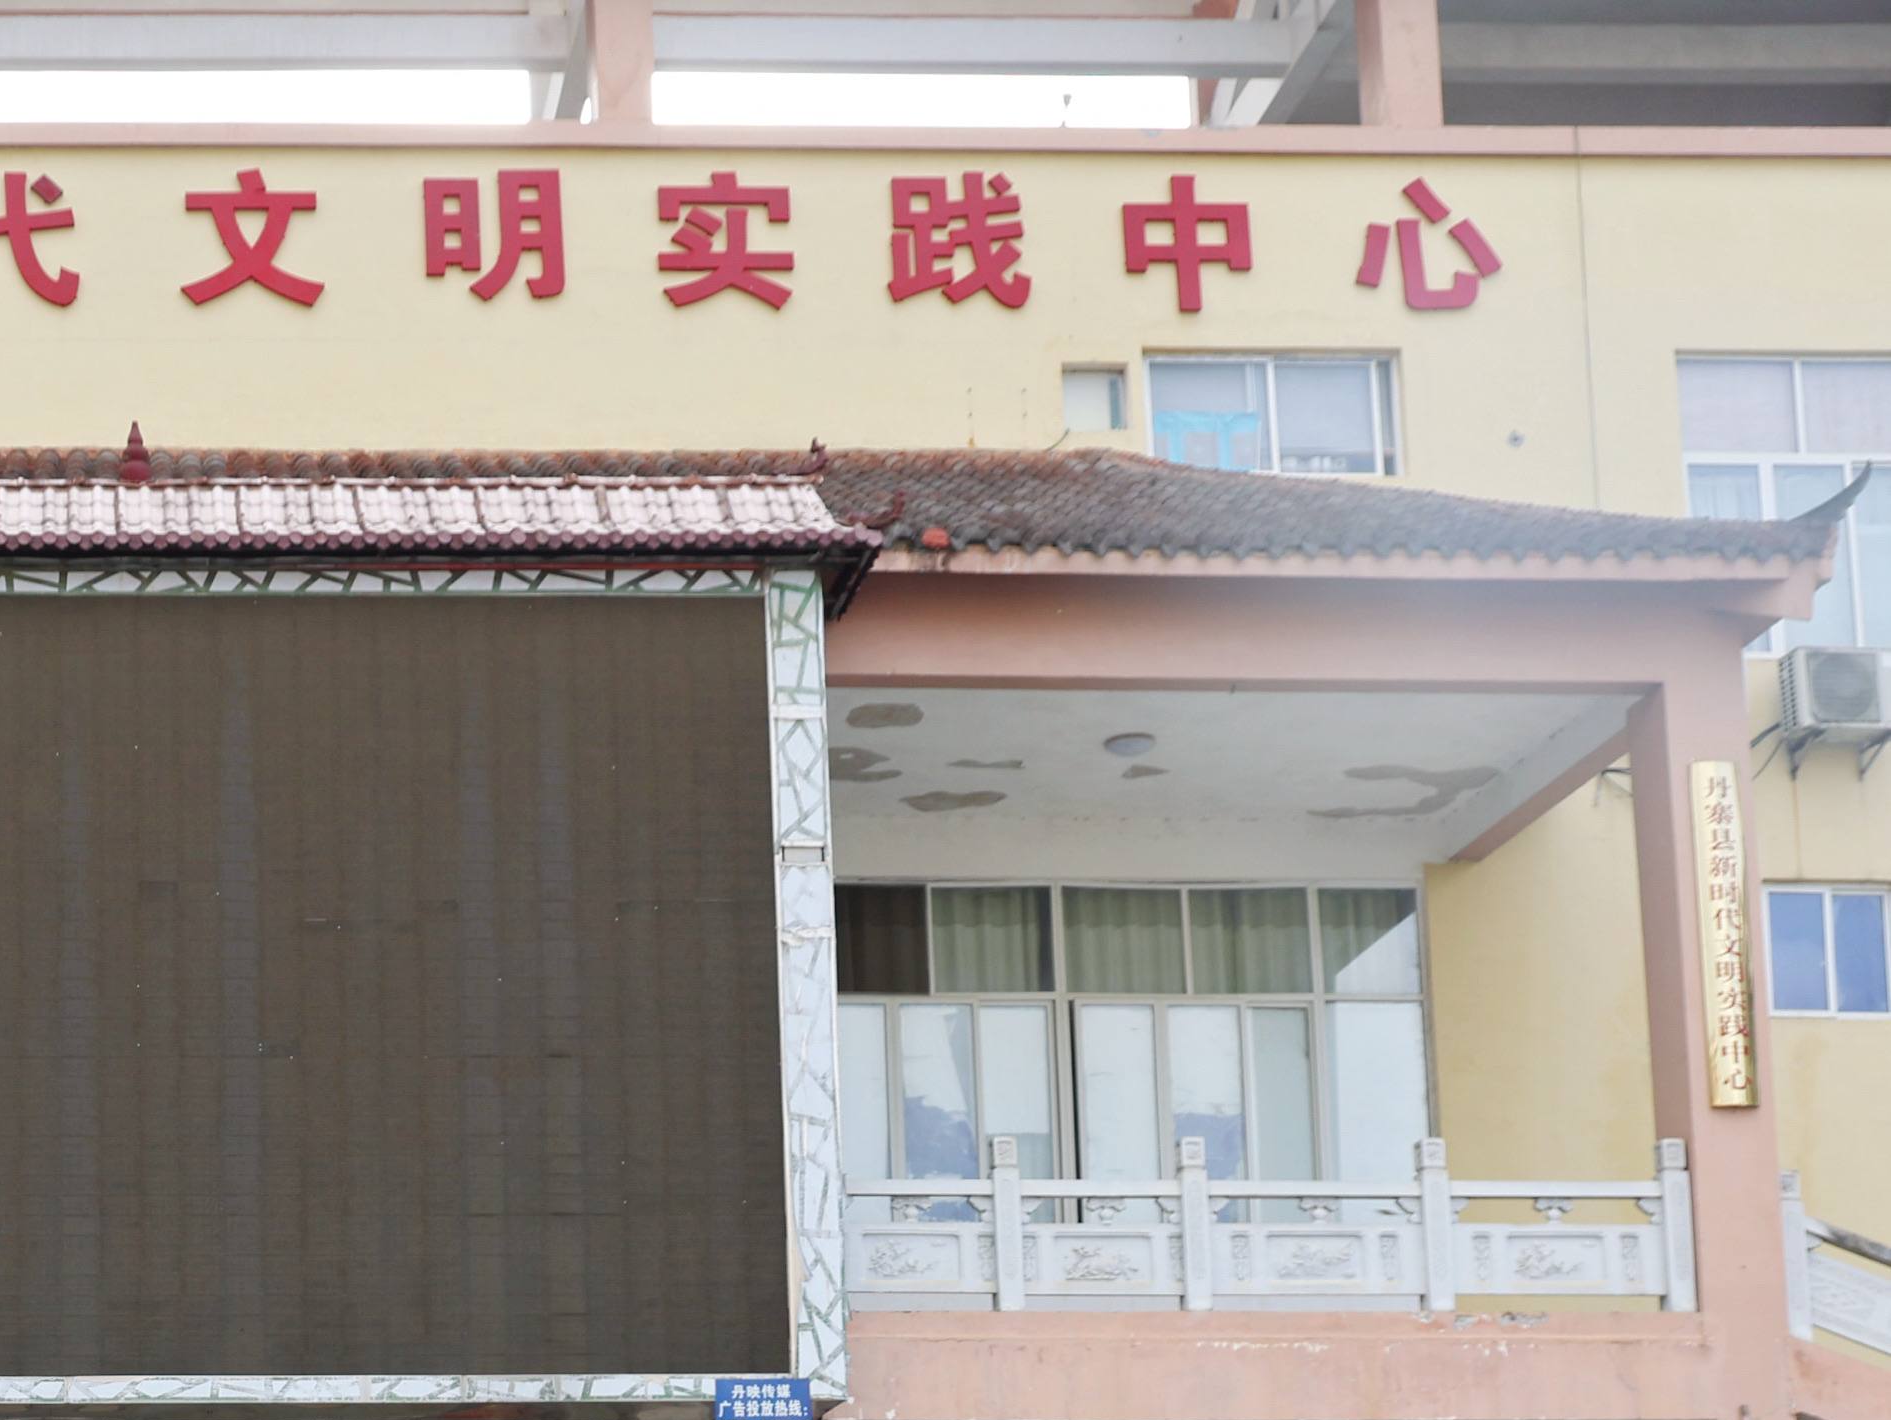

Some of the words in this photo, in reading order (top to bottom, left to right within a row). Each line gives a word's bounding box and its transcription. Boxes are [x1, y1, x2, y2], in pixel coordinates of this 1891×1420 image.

[1704, 774, 1752, 1091] 丹寨县新时代文明实践中心
[731, 1384, 791, 1399] 丹映传媒
